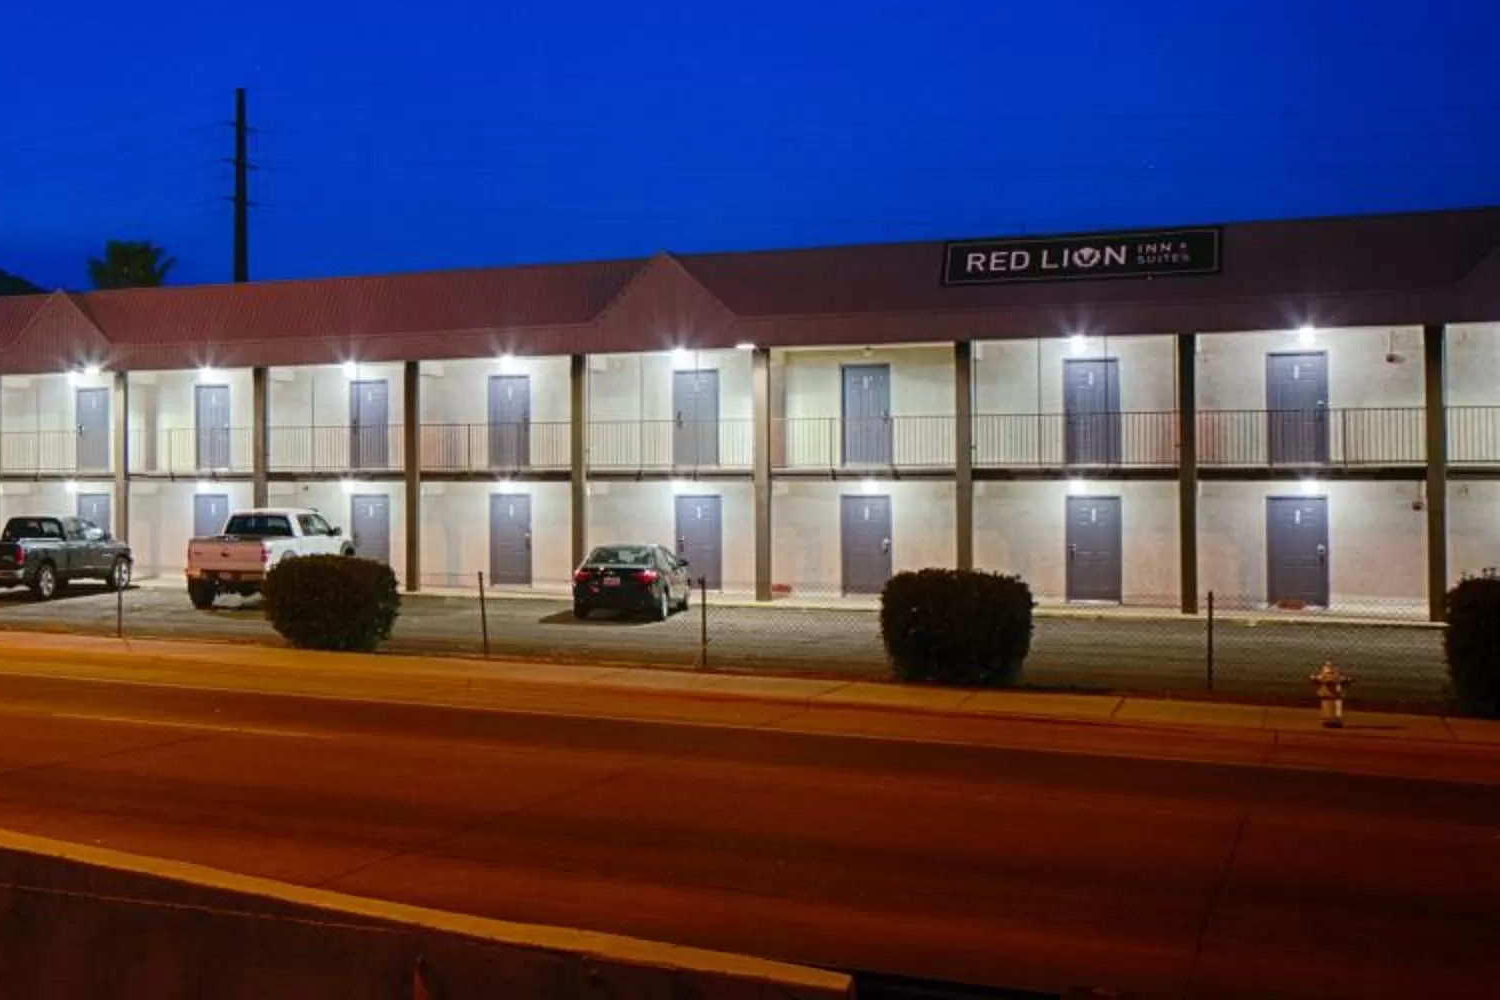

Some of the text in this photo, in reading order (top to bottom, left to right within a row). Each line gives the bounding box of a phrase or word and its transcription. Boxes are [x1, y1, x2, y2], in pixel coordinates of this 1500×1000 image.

[1137, 242, 1172, 254] INN
[966, 246, 1127, 272] RED LION
[1137, 254, 1190, 264] SUITES
